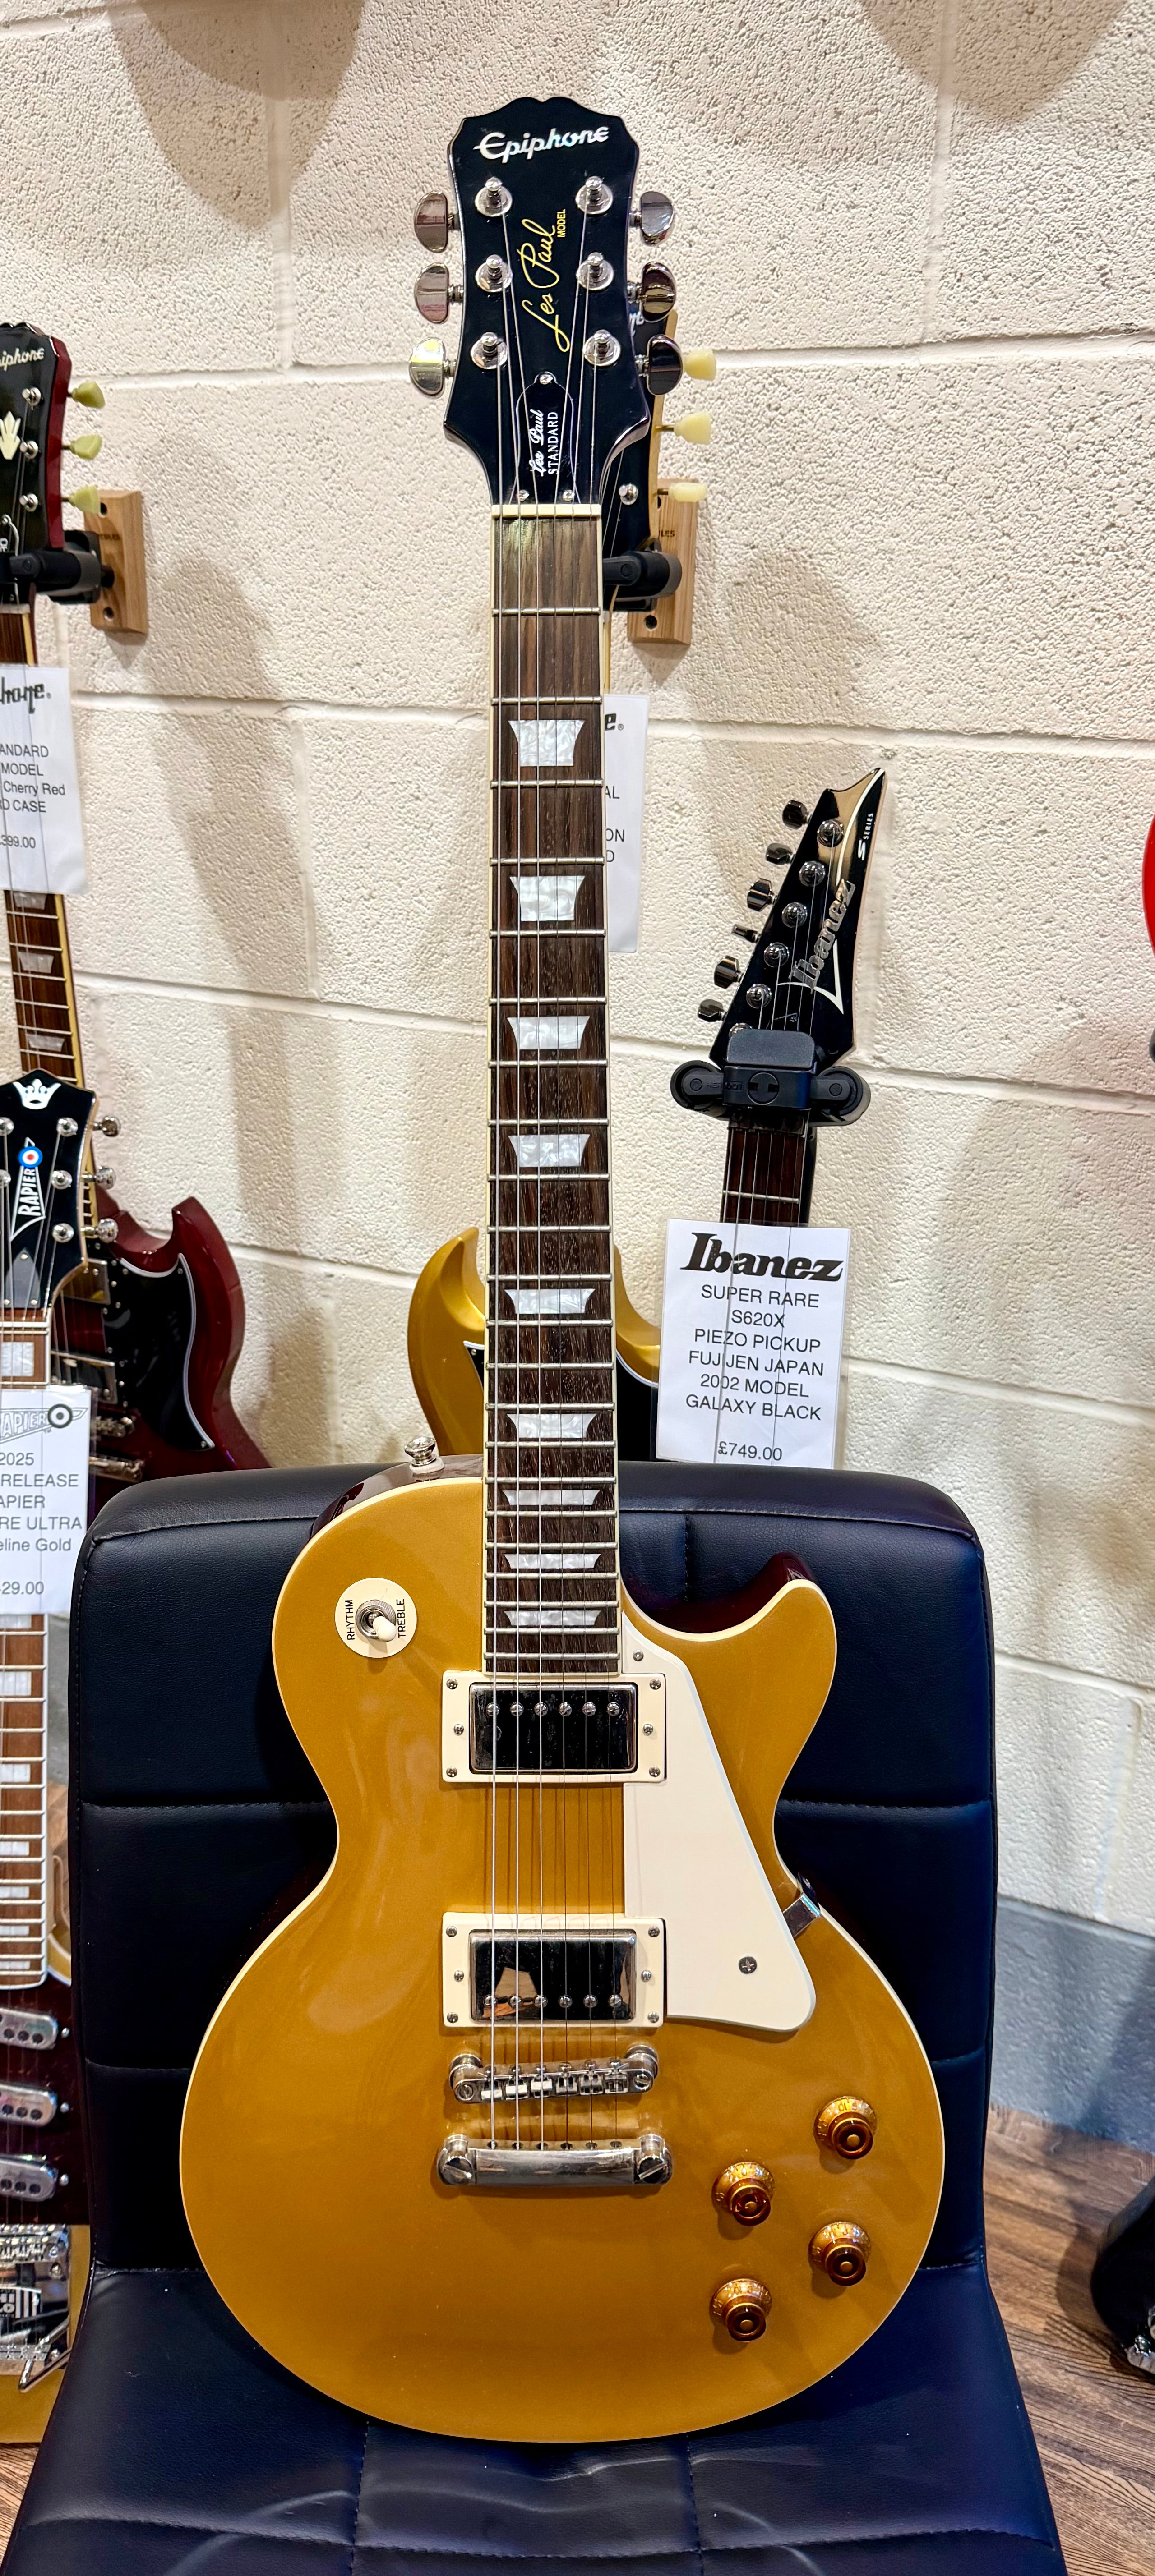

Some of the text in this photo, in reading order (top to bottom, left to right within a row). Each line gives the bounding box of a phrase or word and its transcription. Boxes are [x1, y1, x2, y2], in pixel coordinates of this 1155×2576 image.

[473, 127, 609, 163] Epiphone
[557, 209, 566, 237] MODEL
[516, 219, 570, 352] Les Paul
[547, 412, 559, 474] STANDARD
[1, 763, 44, 776] MODEL
[3, 781, 65, 797] Cherry Red
[13, 800, 46, 813] CASE
[863, 813, 874, 840] SERIES
[788, 879, 856, 994] Ibanez
[18, 1168, 42, 1217] RAPIER
[679, 1232, 844, 1282] Ibanez
[701, 1284, 819, 1308] SUPER RARE
[731, 1310, 785, 1328] S620X
[695, 1329, 821, 1353] PIEZO PICKUP
[764, 1358, 823, 1376] JAPAN
[700, 1374, 809, 1397] 2002 MODEL
[686, 1394, 821, 1420] GALAXY BLACK
[0, 1452, 34, 1466] 2025
[718, 1441, 782, 1461] £749.00
[1, 1474, 79, 1487] RELEASE
[27, 1517, 82, 1530] ULTRA
[36, 1538, 71, 1551] Gold
[345, 1600, 355, 1640] RHYTHM
[396, 1599, 406, 1638] TREBLE
